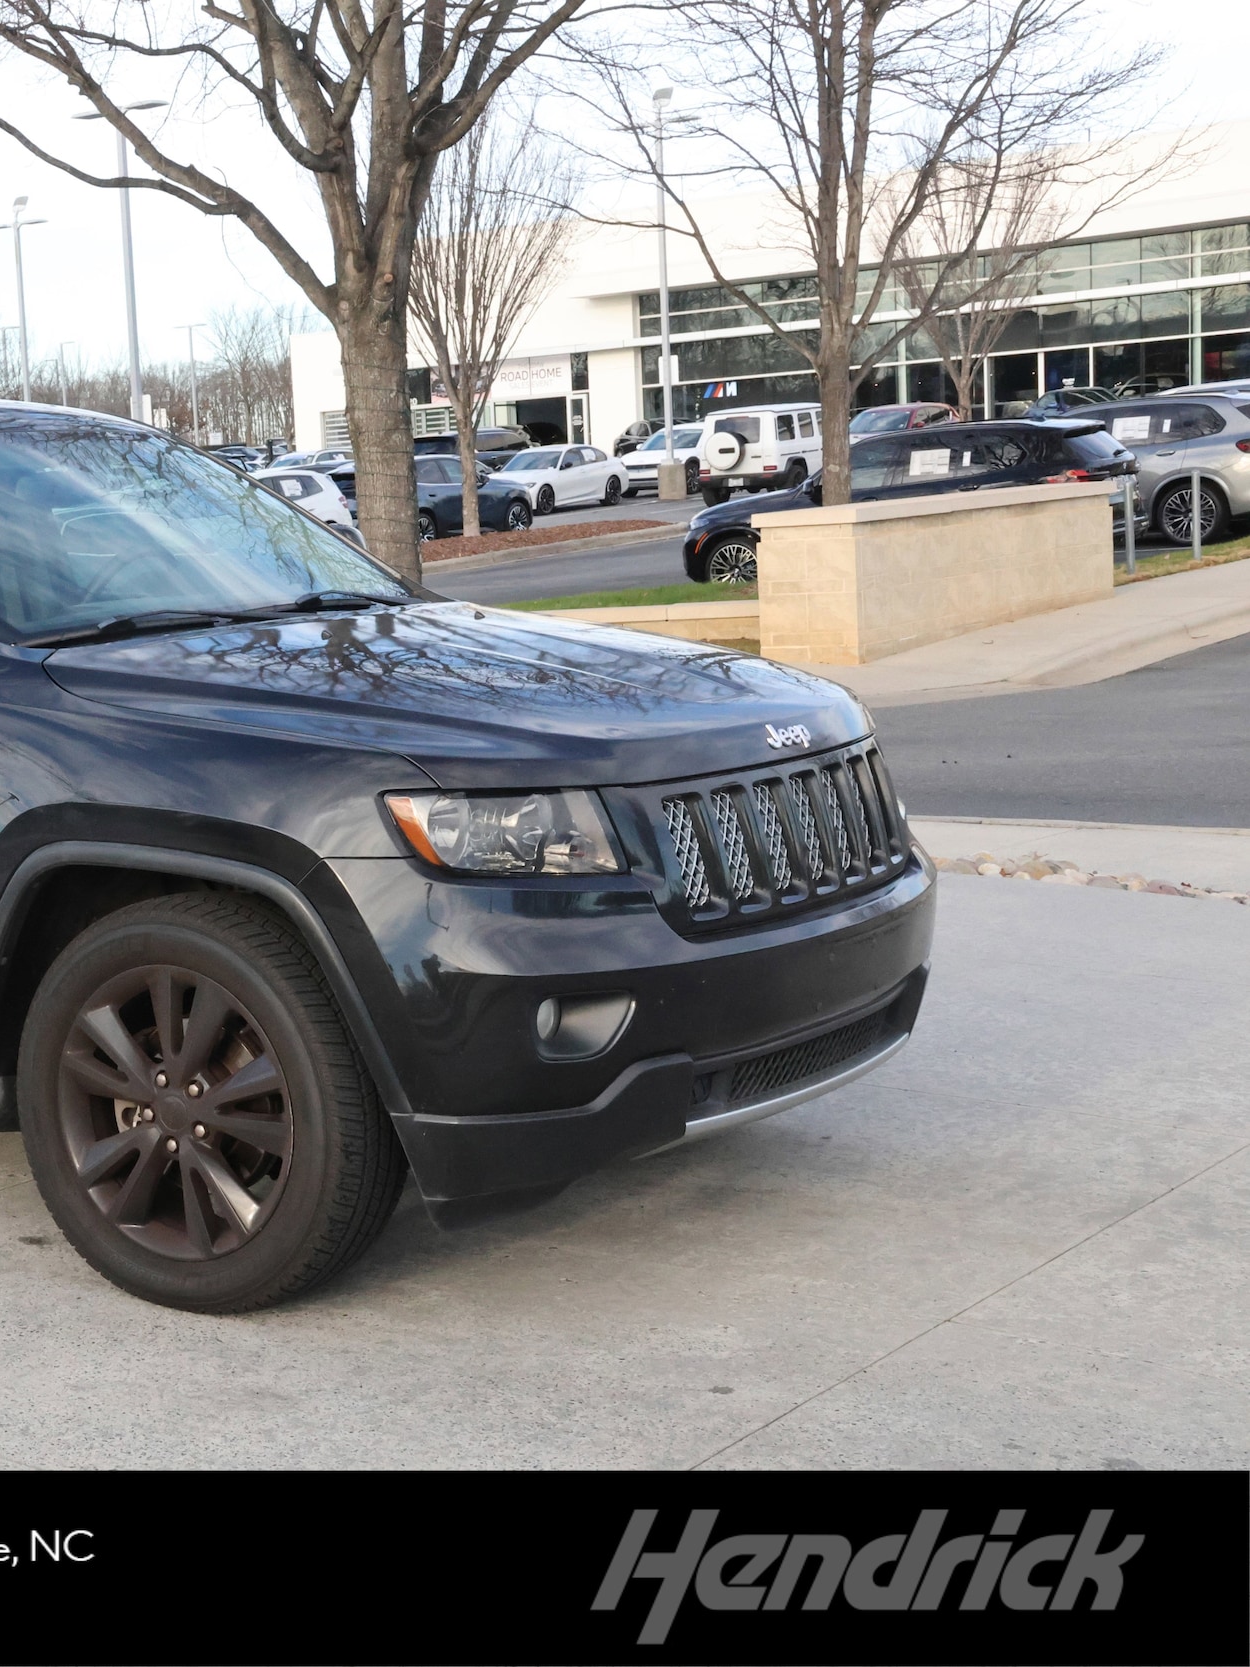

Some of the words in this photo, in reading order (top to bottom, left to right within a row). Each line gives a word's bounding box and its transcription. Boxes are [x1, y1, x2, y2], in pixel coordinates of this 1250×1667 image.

[500, 370, 529, 382] ROAD
[531, 367, 562, 379] HOME
[765, 724, 811, 749] Jeep
